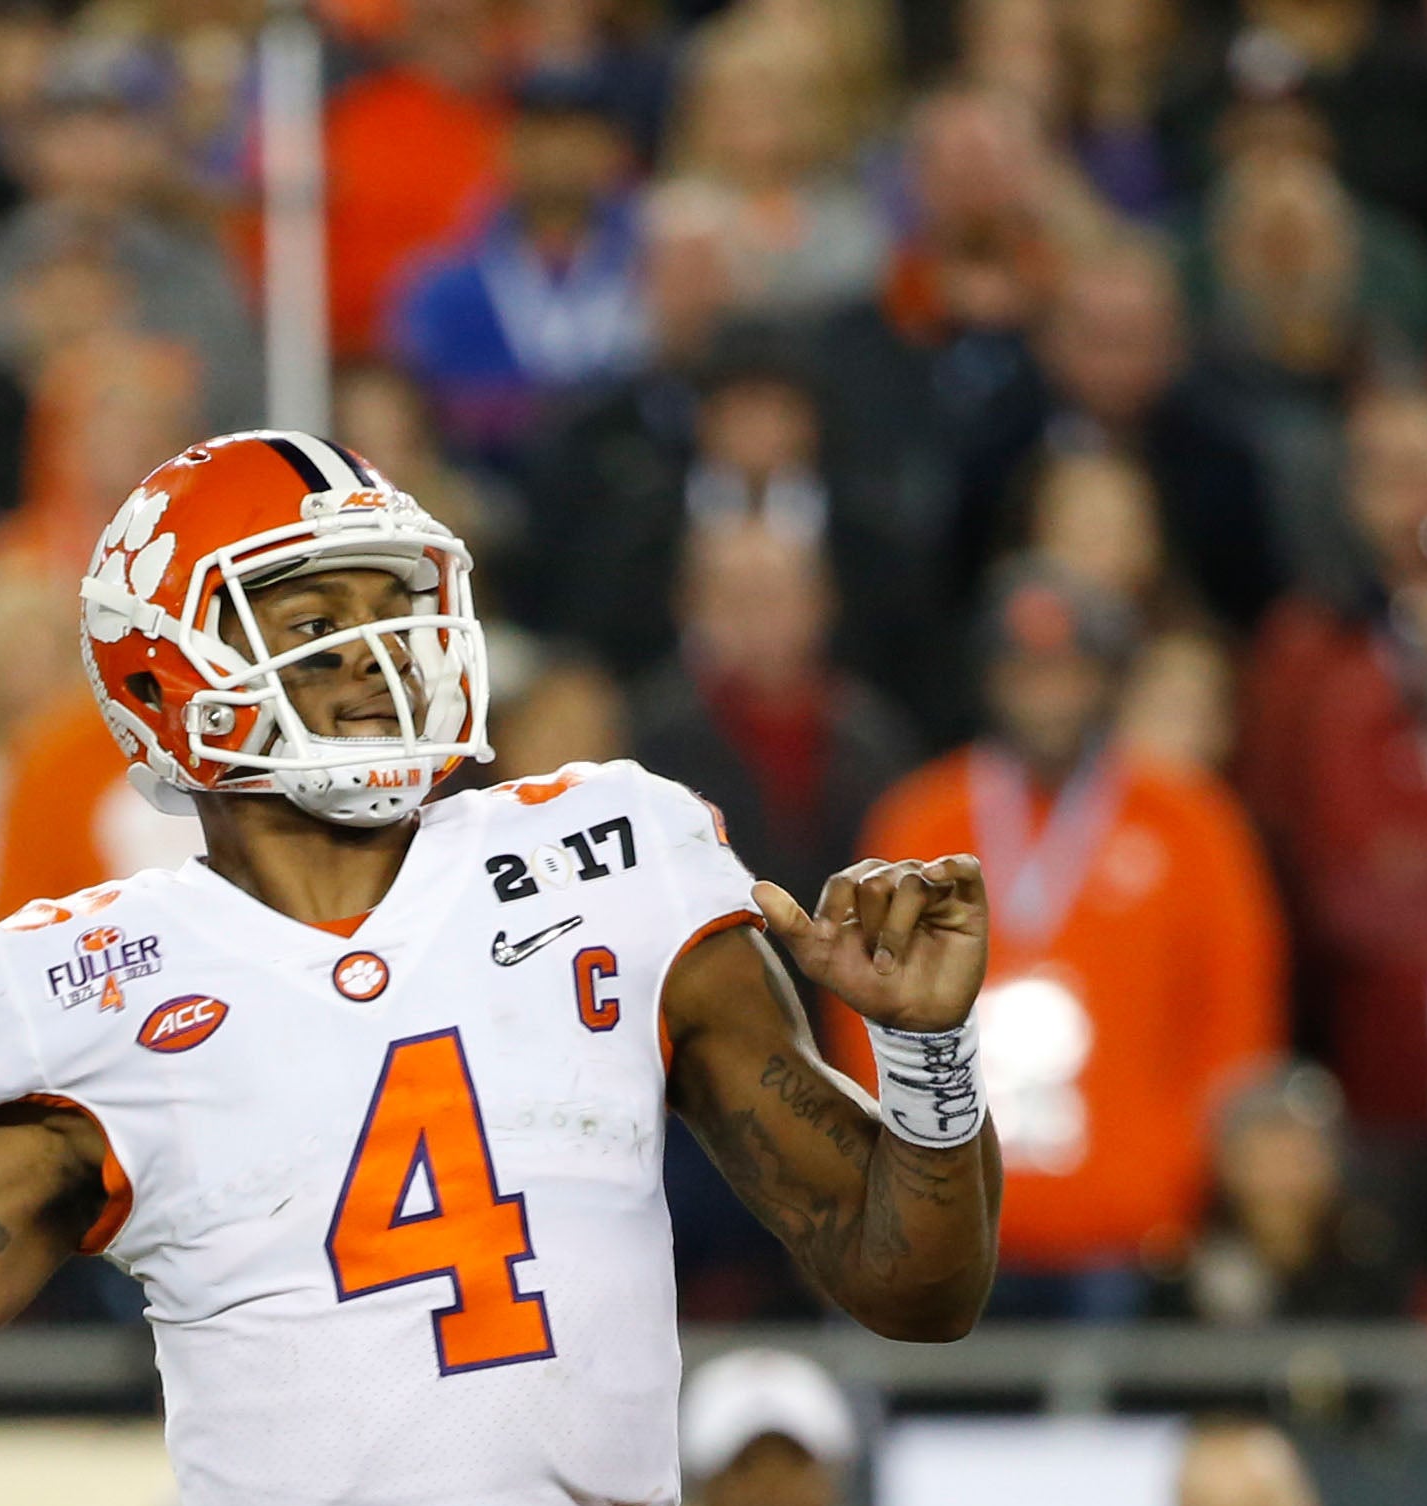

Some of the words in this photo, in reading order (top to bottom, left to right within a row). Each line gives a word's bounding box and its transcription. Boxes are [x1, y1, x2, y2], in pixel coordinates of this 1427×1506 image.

[340, 491, 387, 507] ACC
[366, 769, 403, 788] ALL
[406, 768, 421, 787] IN
[47, 934, 161, 996] FULLER
[572, 946, 620, 1032] C
[150, 999, 217, 1041] ACC
[324, 1025, 557, 1377] 4
